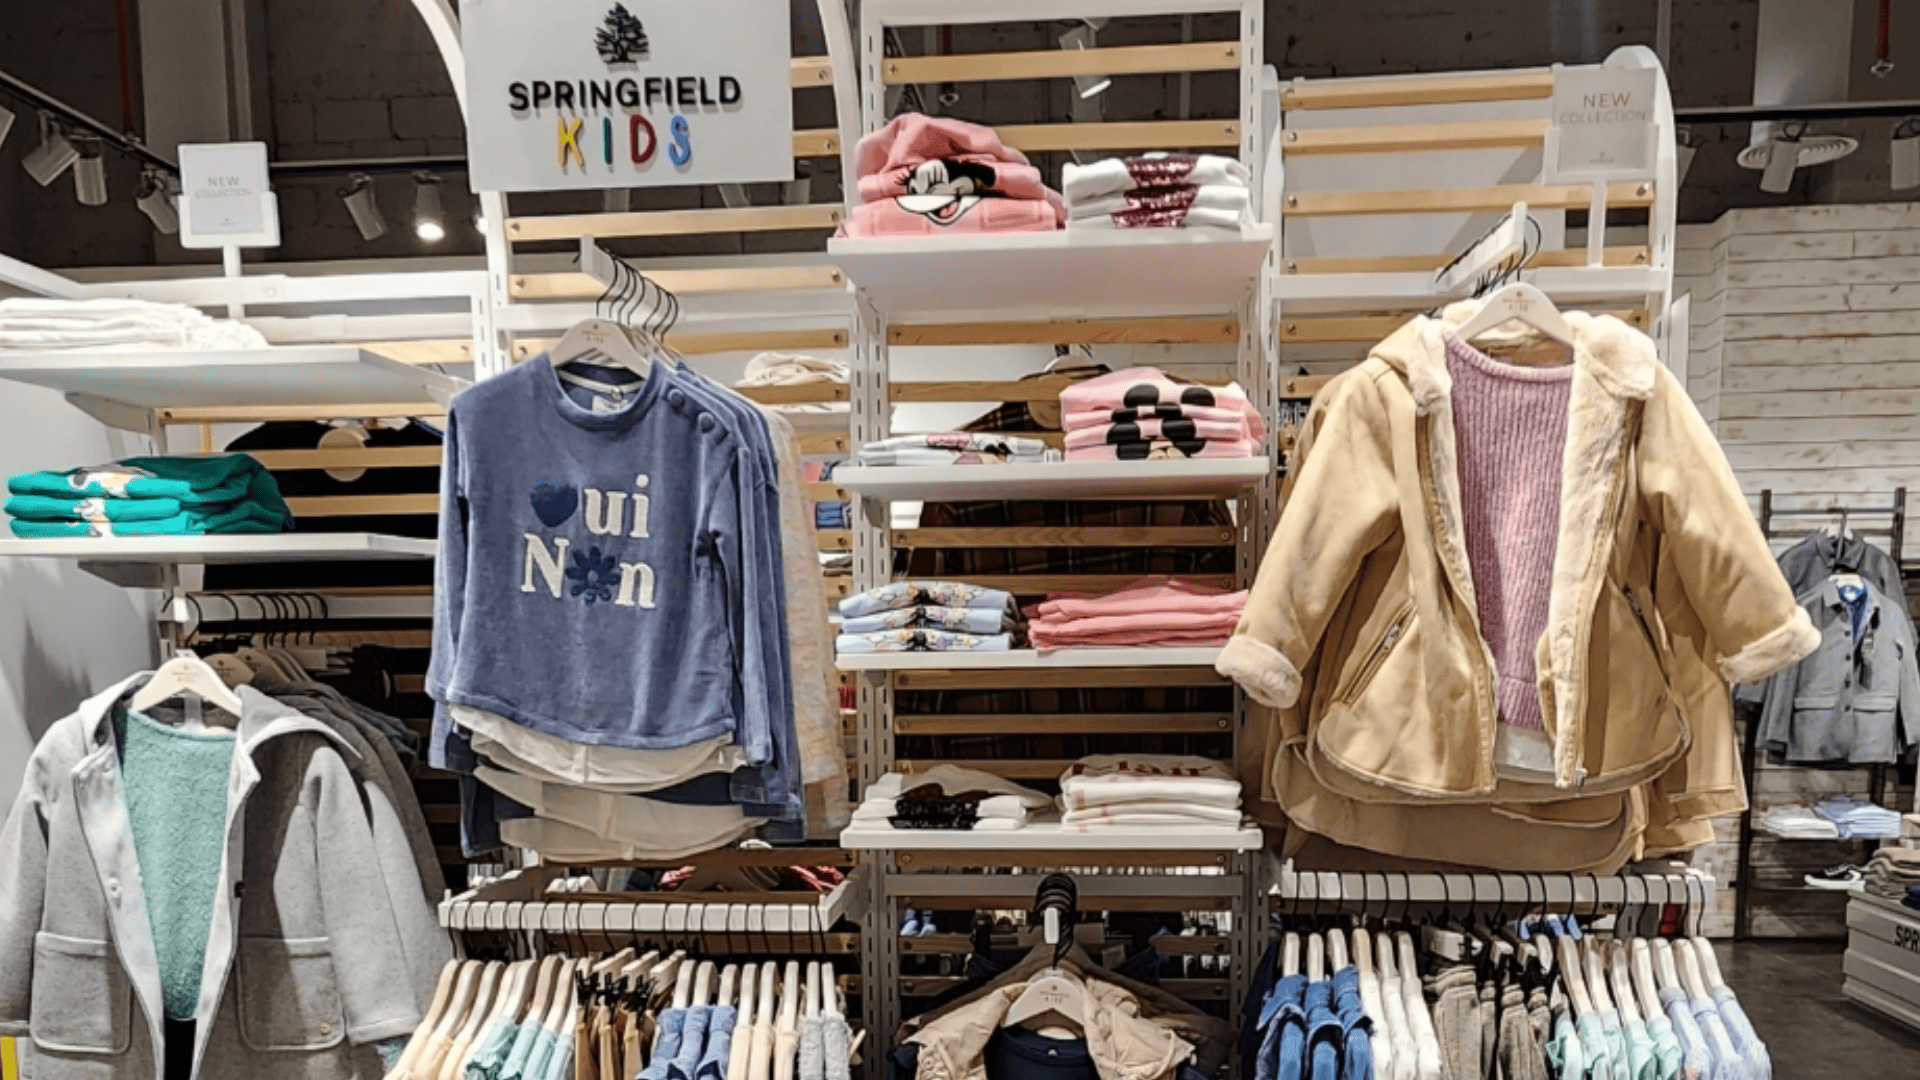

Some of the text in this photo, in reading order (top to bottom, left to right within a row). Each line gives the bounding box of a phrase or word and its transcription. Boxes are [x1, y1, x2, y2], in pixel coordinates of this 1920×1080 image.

[508, 76, 742, 111] SPRINGFIELD
[1583, 91, 1631, 108] NEW
[1559, 109, 1646, 124] COLLECTION
[557, 113, 692, 167] KIDS
[207, 175, 240, 188] NEW
